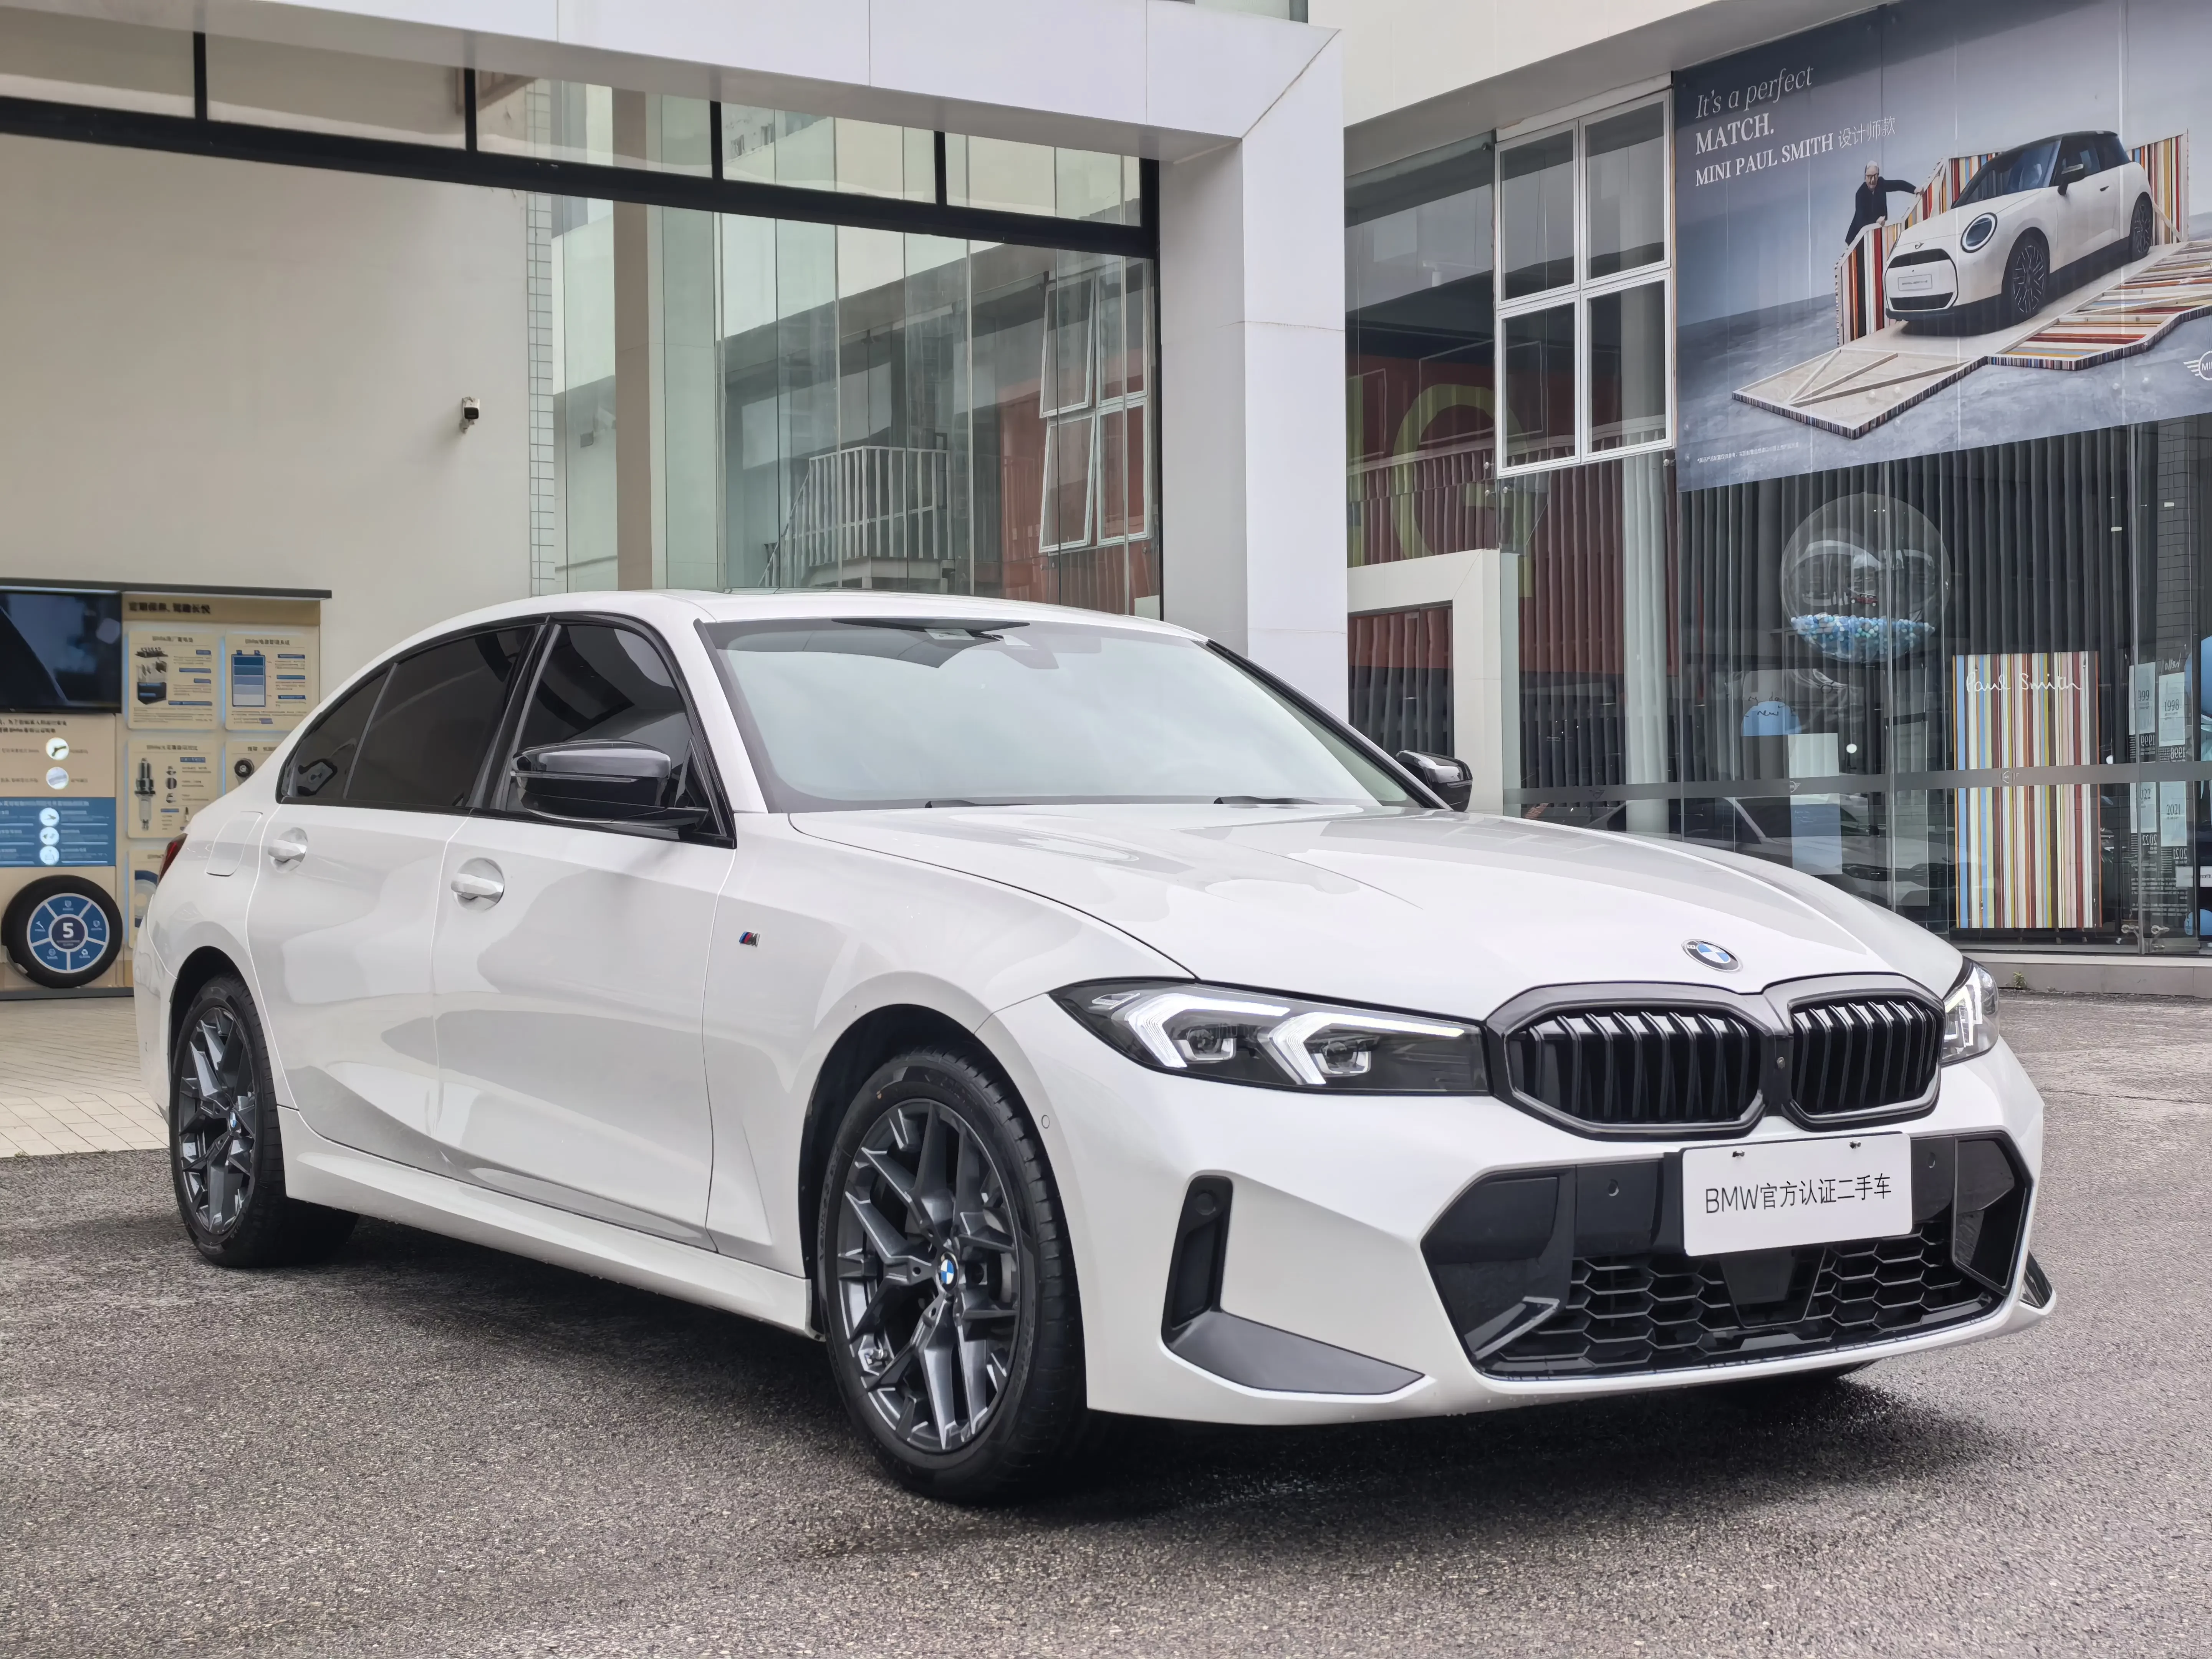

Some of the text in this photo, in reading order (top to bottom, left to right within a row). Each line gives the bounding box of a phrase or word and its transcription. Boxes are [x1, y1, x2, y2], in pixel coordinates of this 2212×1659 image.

[1695, 65, 1814, 119] It's a perfect
[1695, 113, 1774, 155] MATCH.
[1695, 116, 1896, 187] MINI PAUL SMITH 设计师款
[2201, 361, 2212, 371] MI
[1966, 671, 2083, 692] Paul Smith
[2138, 689, 2149, 701] 999
[63, 922, 75, 939] 5
[1705, 1173, 1892, 1214] BMW官方认证二手车
